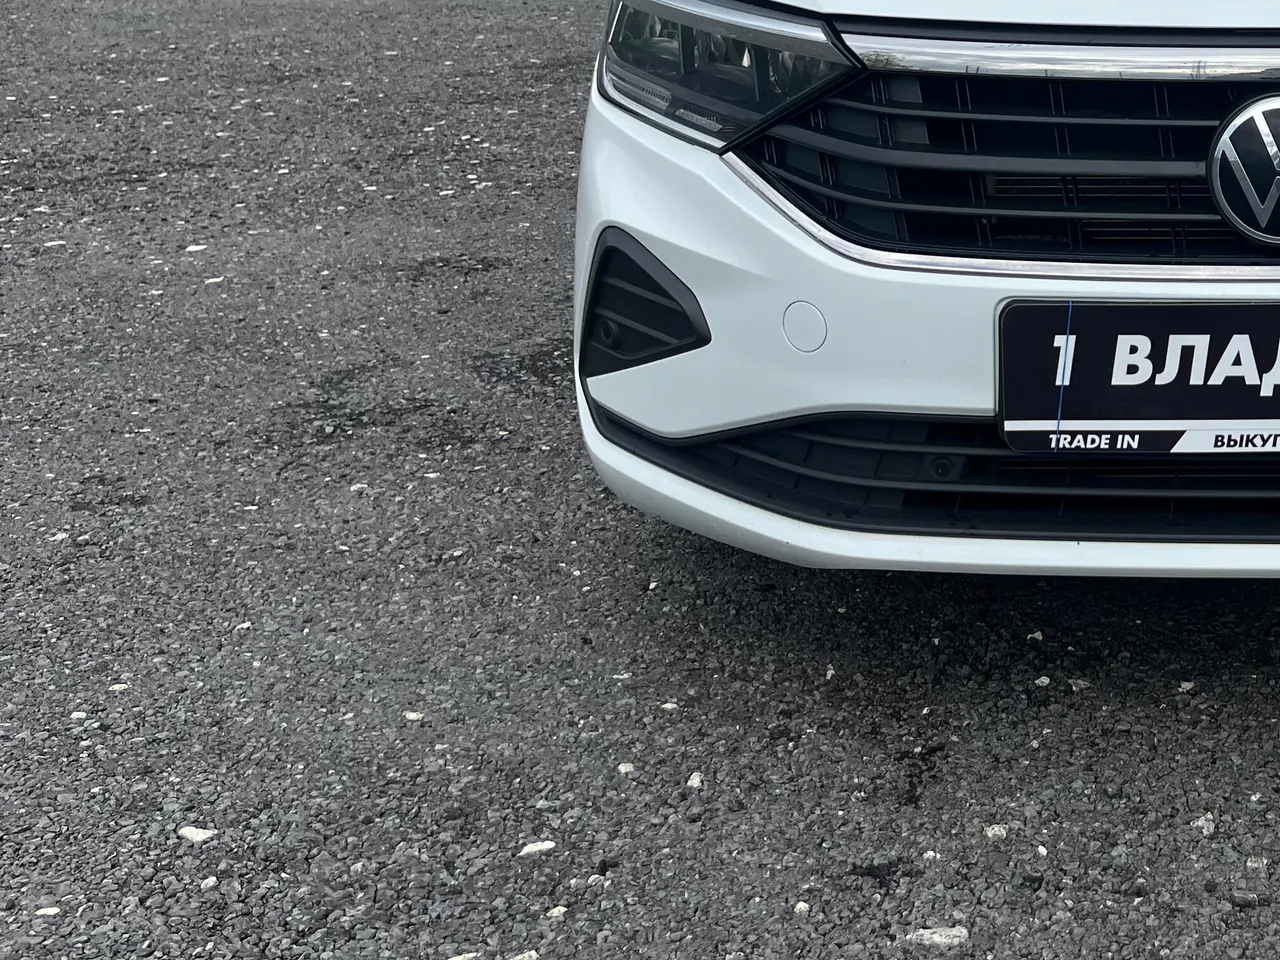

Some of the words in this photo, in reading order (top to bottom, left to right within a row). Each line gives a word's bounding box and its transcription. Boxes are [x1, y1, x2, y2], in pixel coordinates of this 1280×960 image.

[1053, 334, 1077, 386] 1
[1049, 434, 1111, 449] TRADE
[1116, 434, 1140, 449] IN
